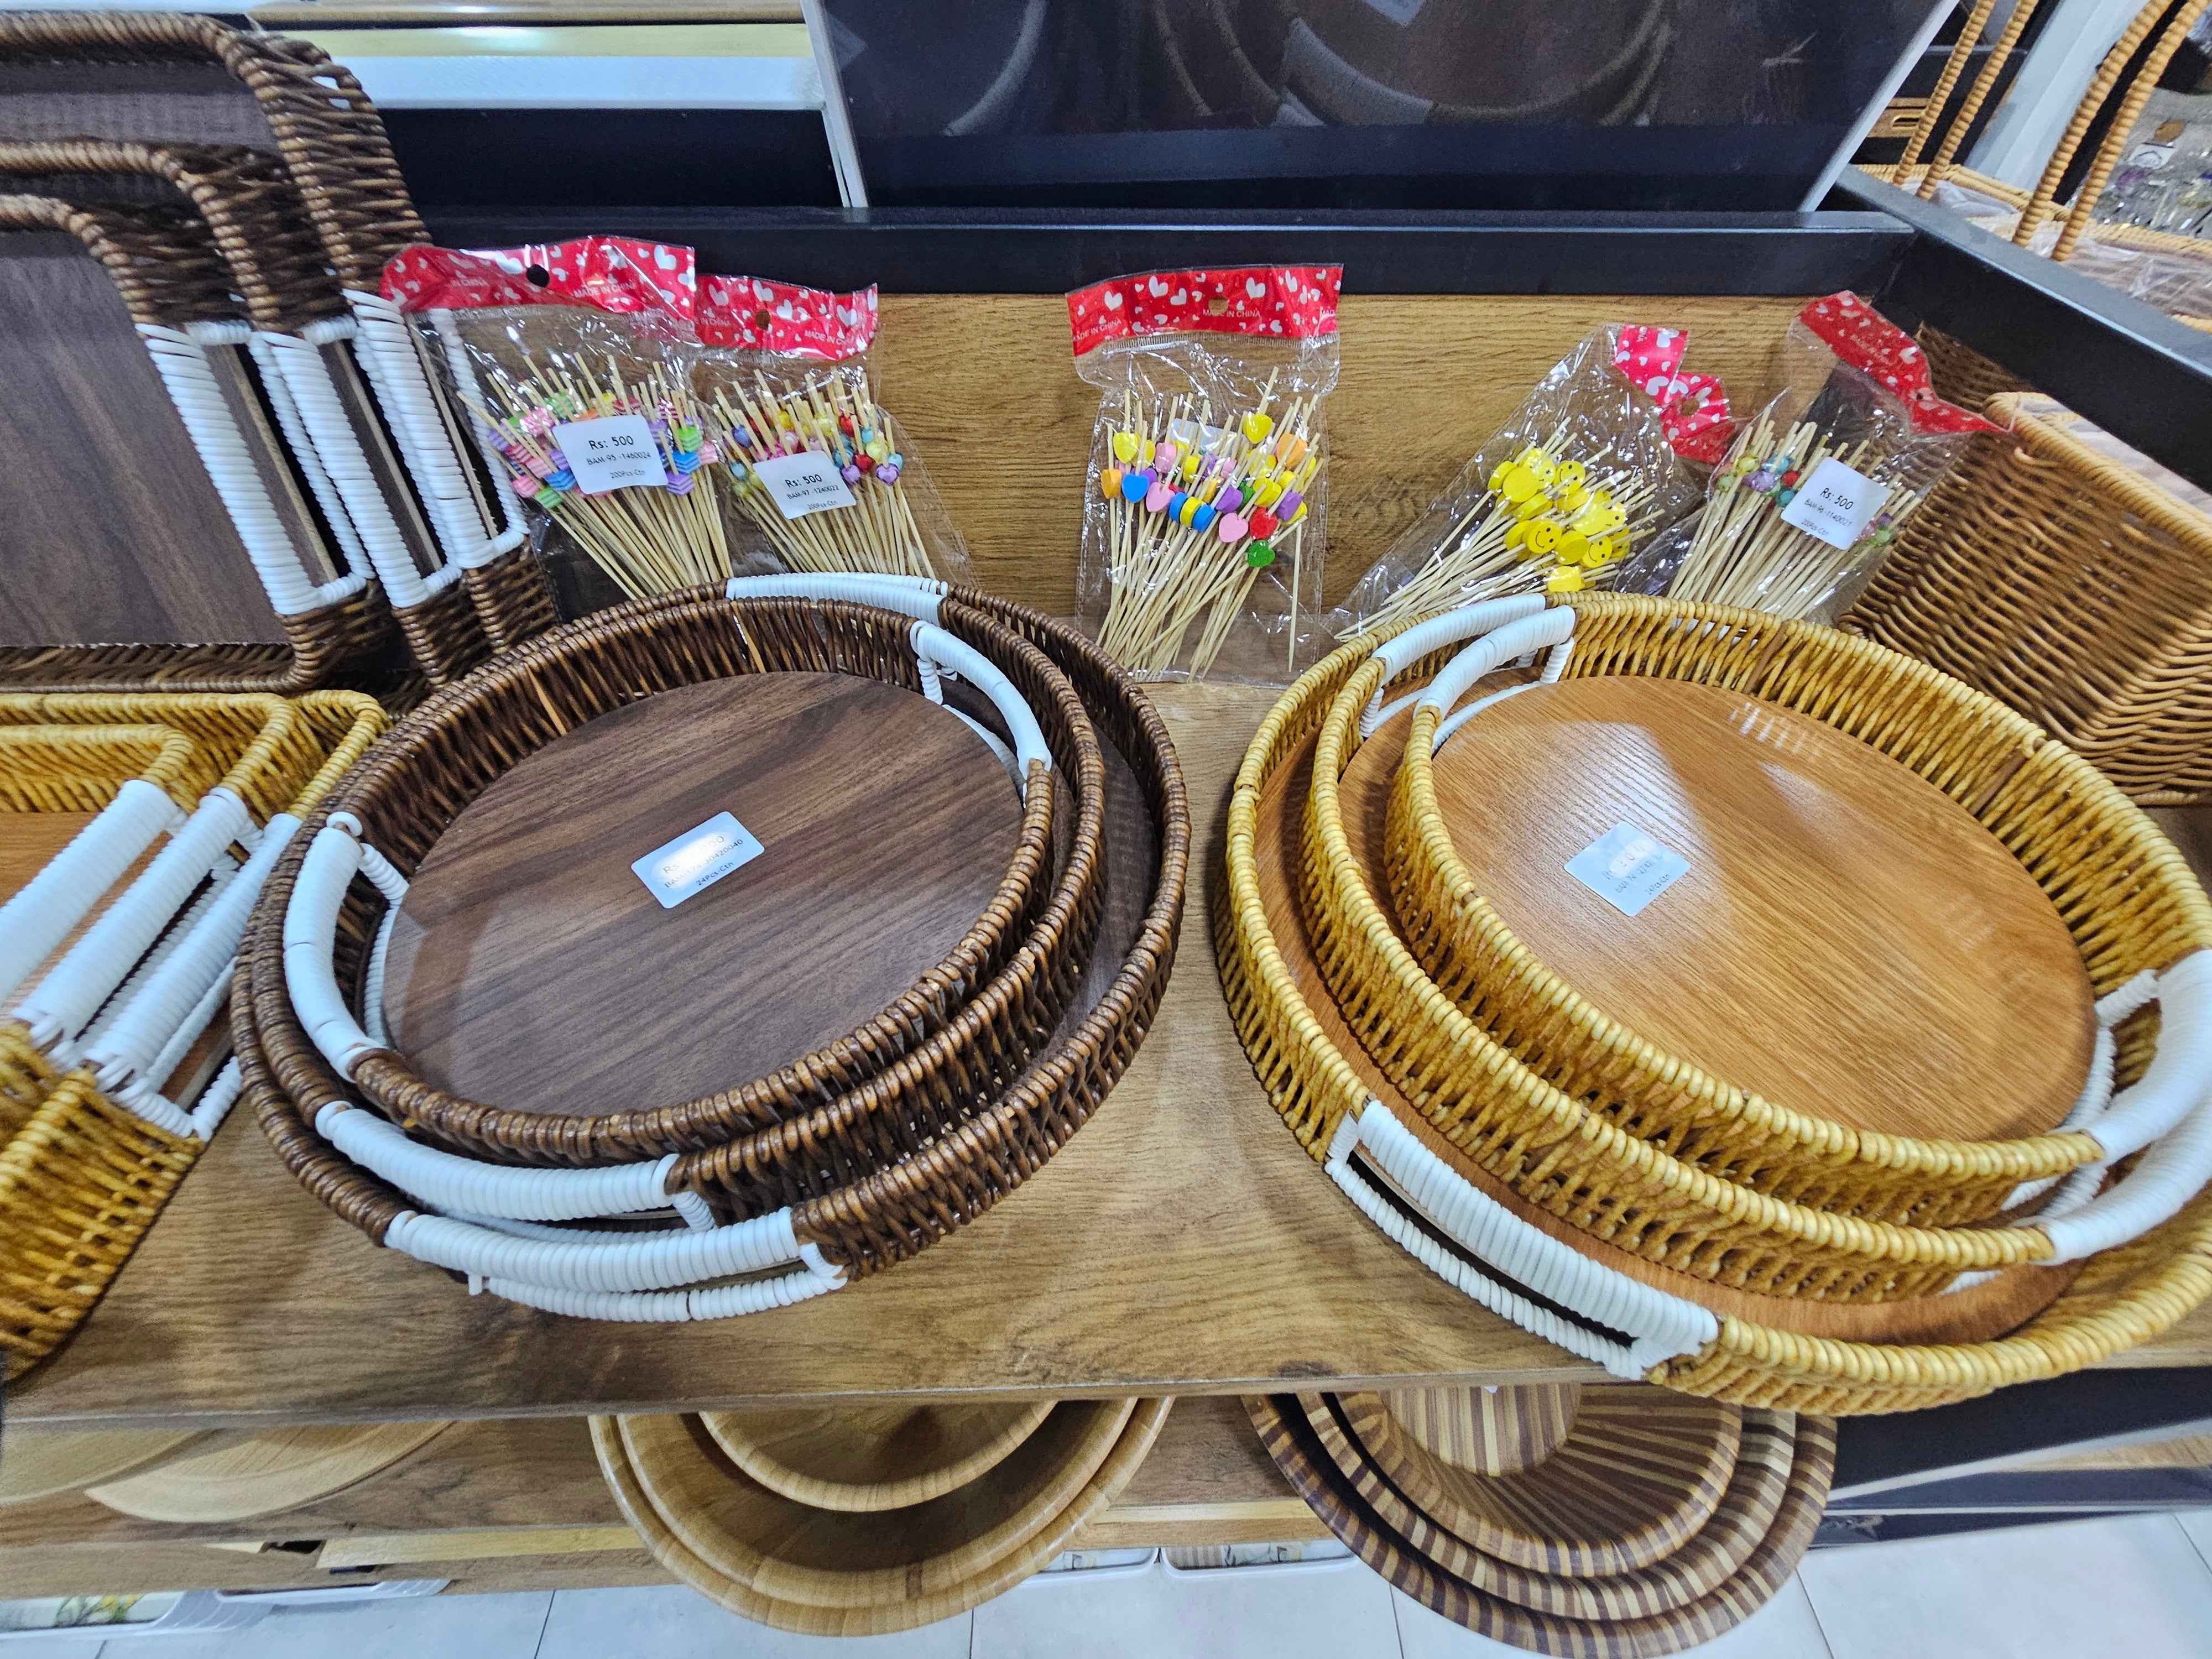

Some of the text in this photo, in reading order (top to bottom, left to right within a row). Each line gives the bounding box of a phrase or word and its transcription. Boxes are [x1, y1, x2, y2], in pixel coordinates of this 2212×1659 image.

[573, 286, 601, 298] MADE
[601, 285, 611, 294] IN
[1091, 326, 1098, 335] IN
[1099, 317, 1122, 331] CHINA
[804, 330, 826, 341] MADE
[588, 435, 634, 450] Rs: 500
[785, 474, 822, 488] Rs: 500
[1819, 487, 1854, 510] Rs: 500
